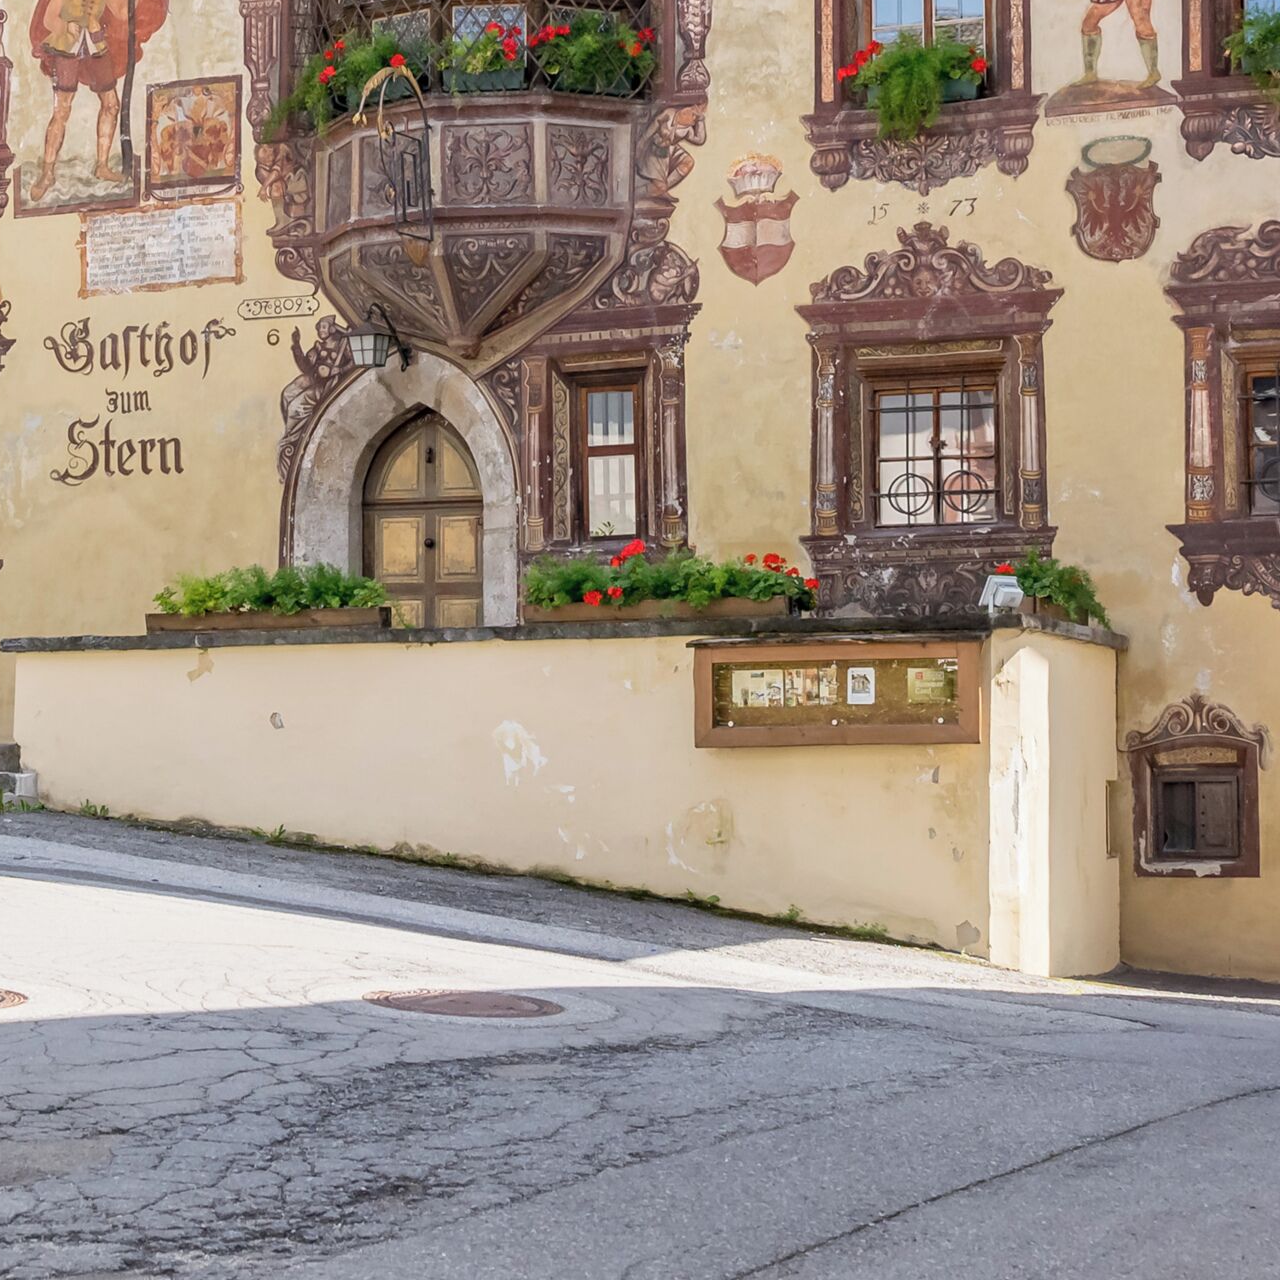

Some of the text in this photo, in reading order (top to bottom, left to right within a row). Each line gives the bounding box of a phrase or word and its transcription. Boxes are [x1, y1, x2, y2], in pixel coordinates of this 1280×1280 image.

[867, 197, 978, 225] 15 73
[274, 297, 303, 315] 809
[43, 316, 237, 381] Gasthof
[266, 328, 280, 346] 6
[105, 387, 153, 415] zum
[49, 413, 185, 487] Stern
